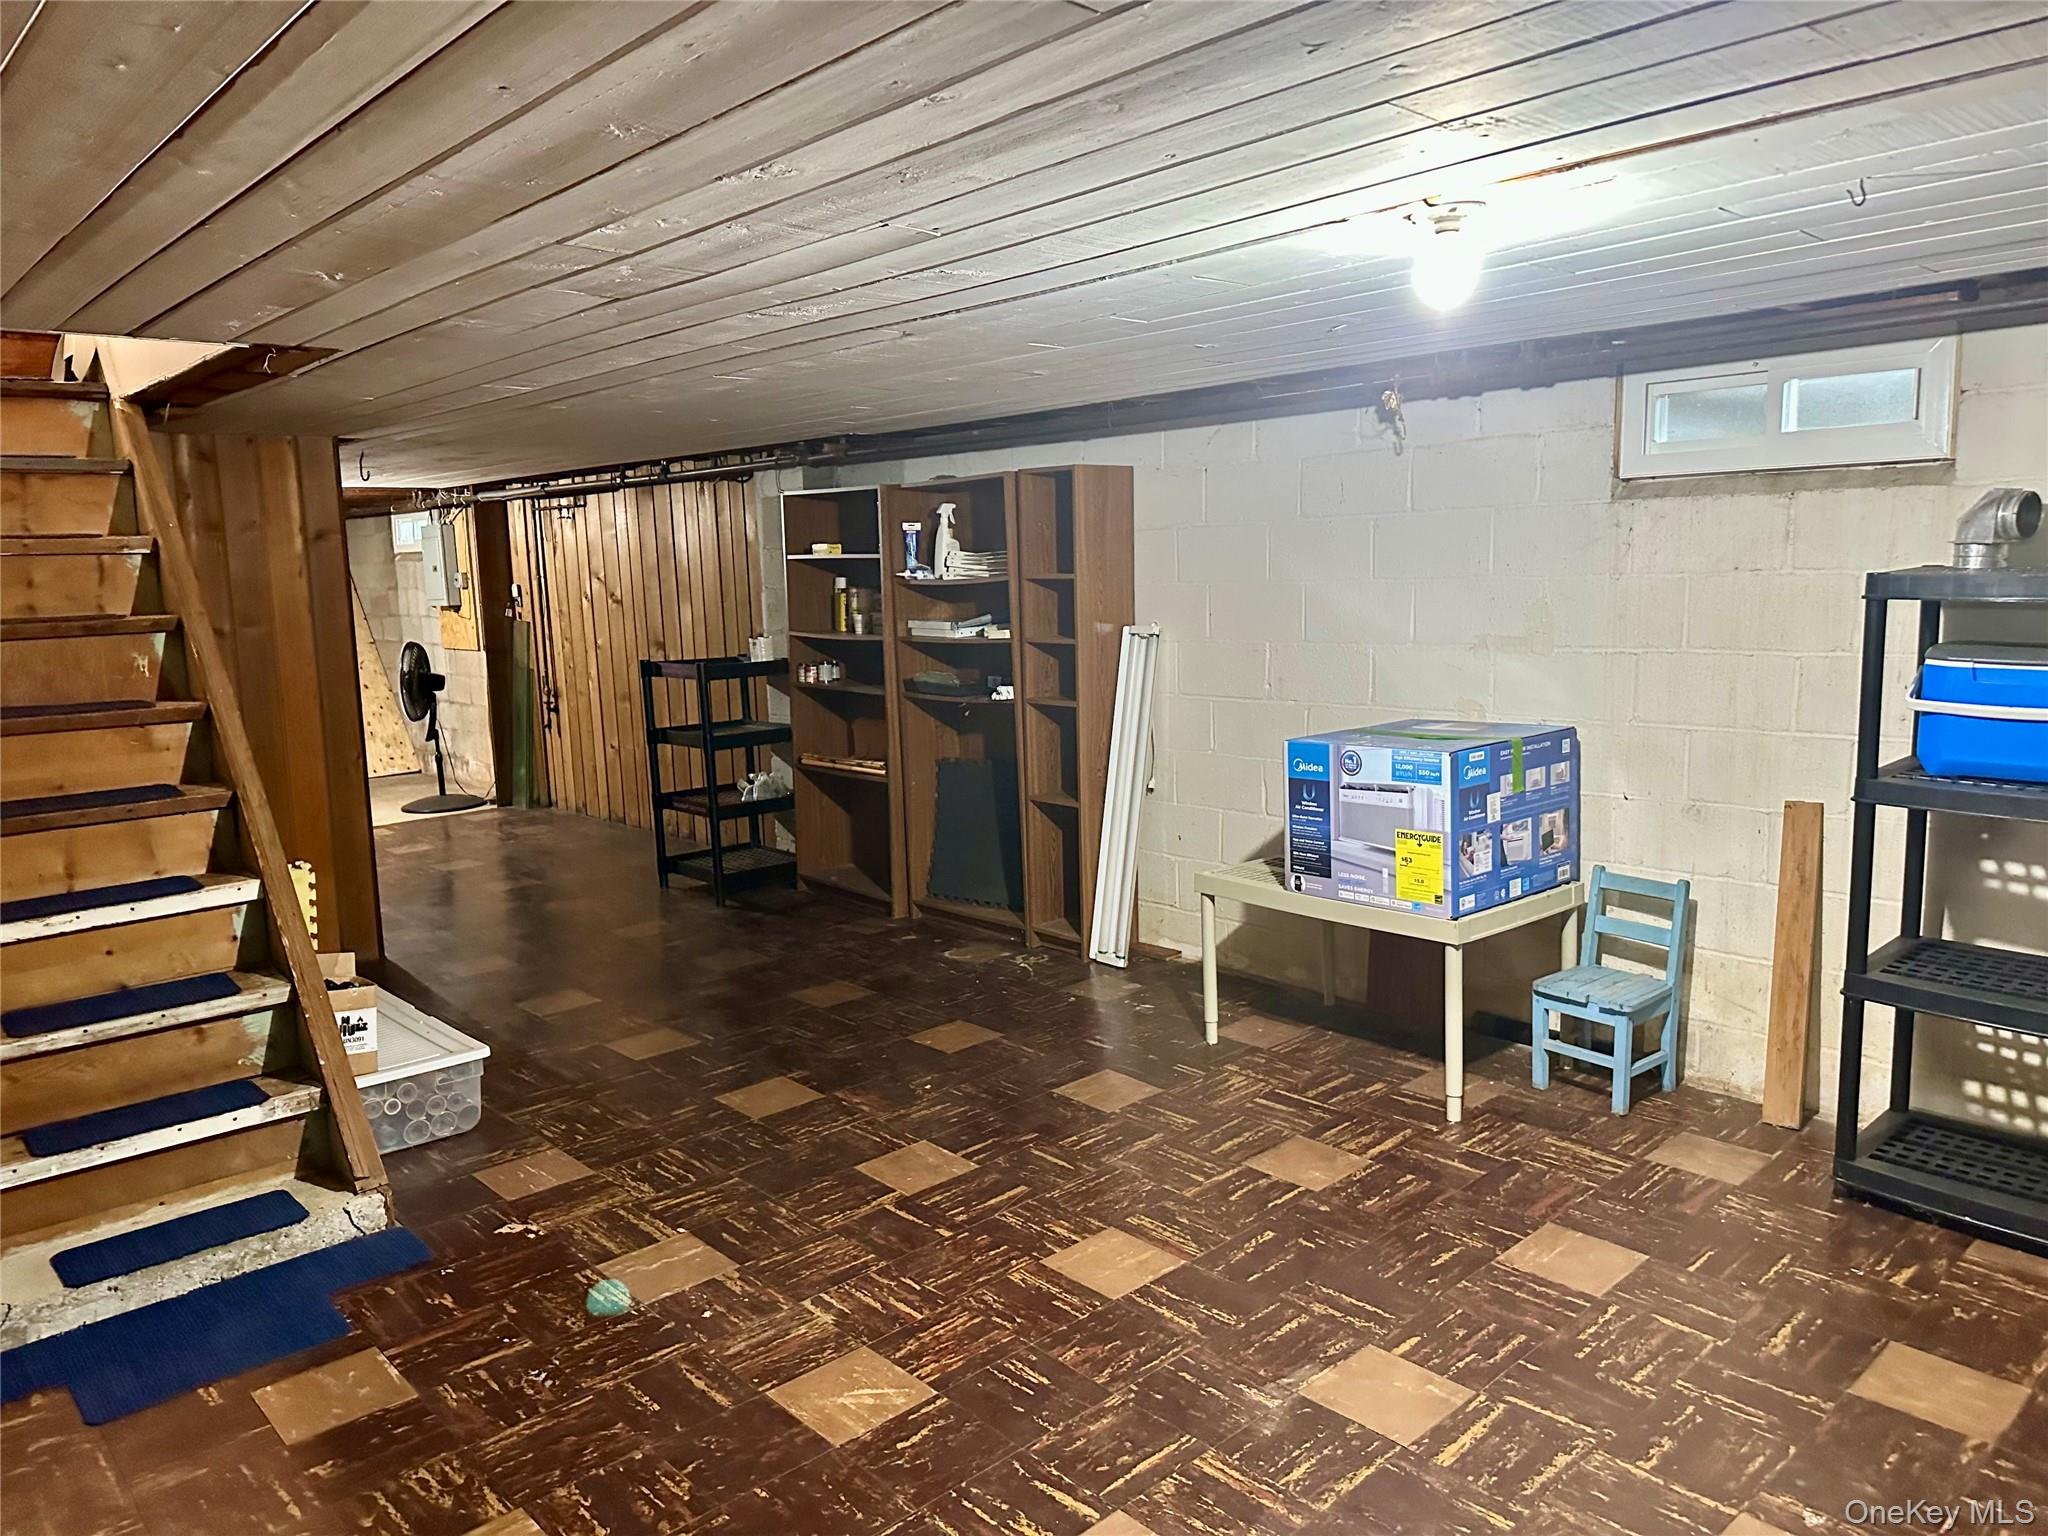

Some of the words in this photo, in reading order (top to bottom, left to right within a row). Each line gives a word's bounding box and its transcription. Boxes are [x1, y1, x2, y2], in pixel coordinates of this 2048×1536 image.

[1293, 758, 1324, 773] Midea
[1395, 763, 1414, 771] 12,000
[1463, 765, 1487, 780] Midea
[1396, 831, 1442, 844] ENERGYGUIDE
